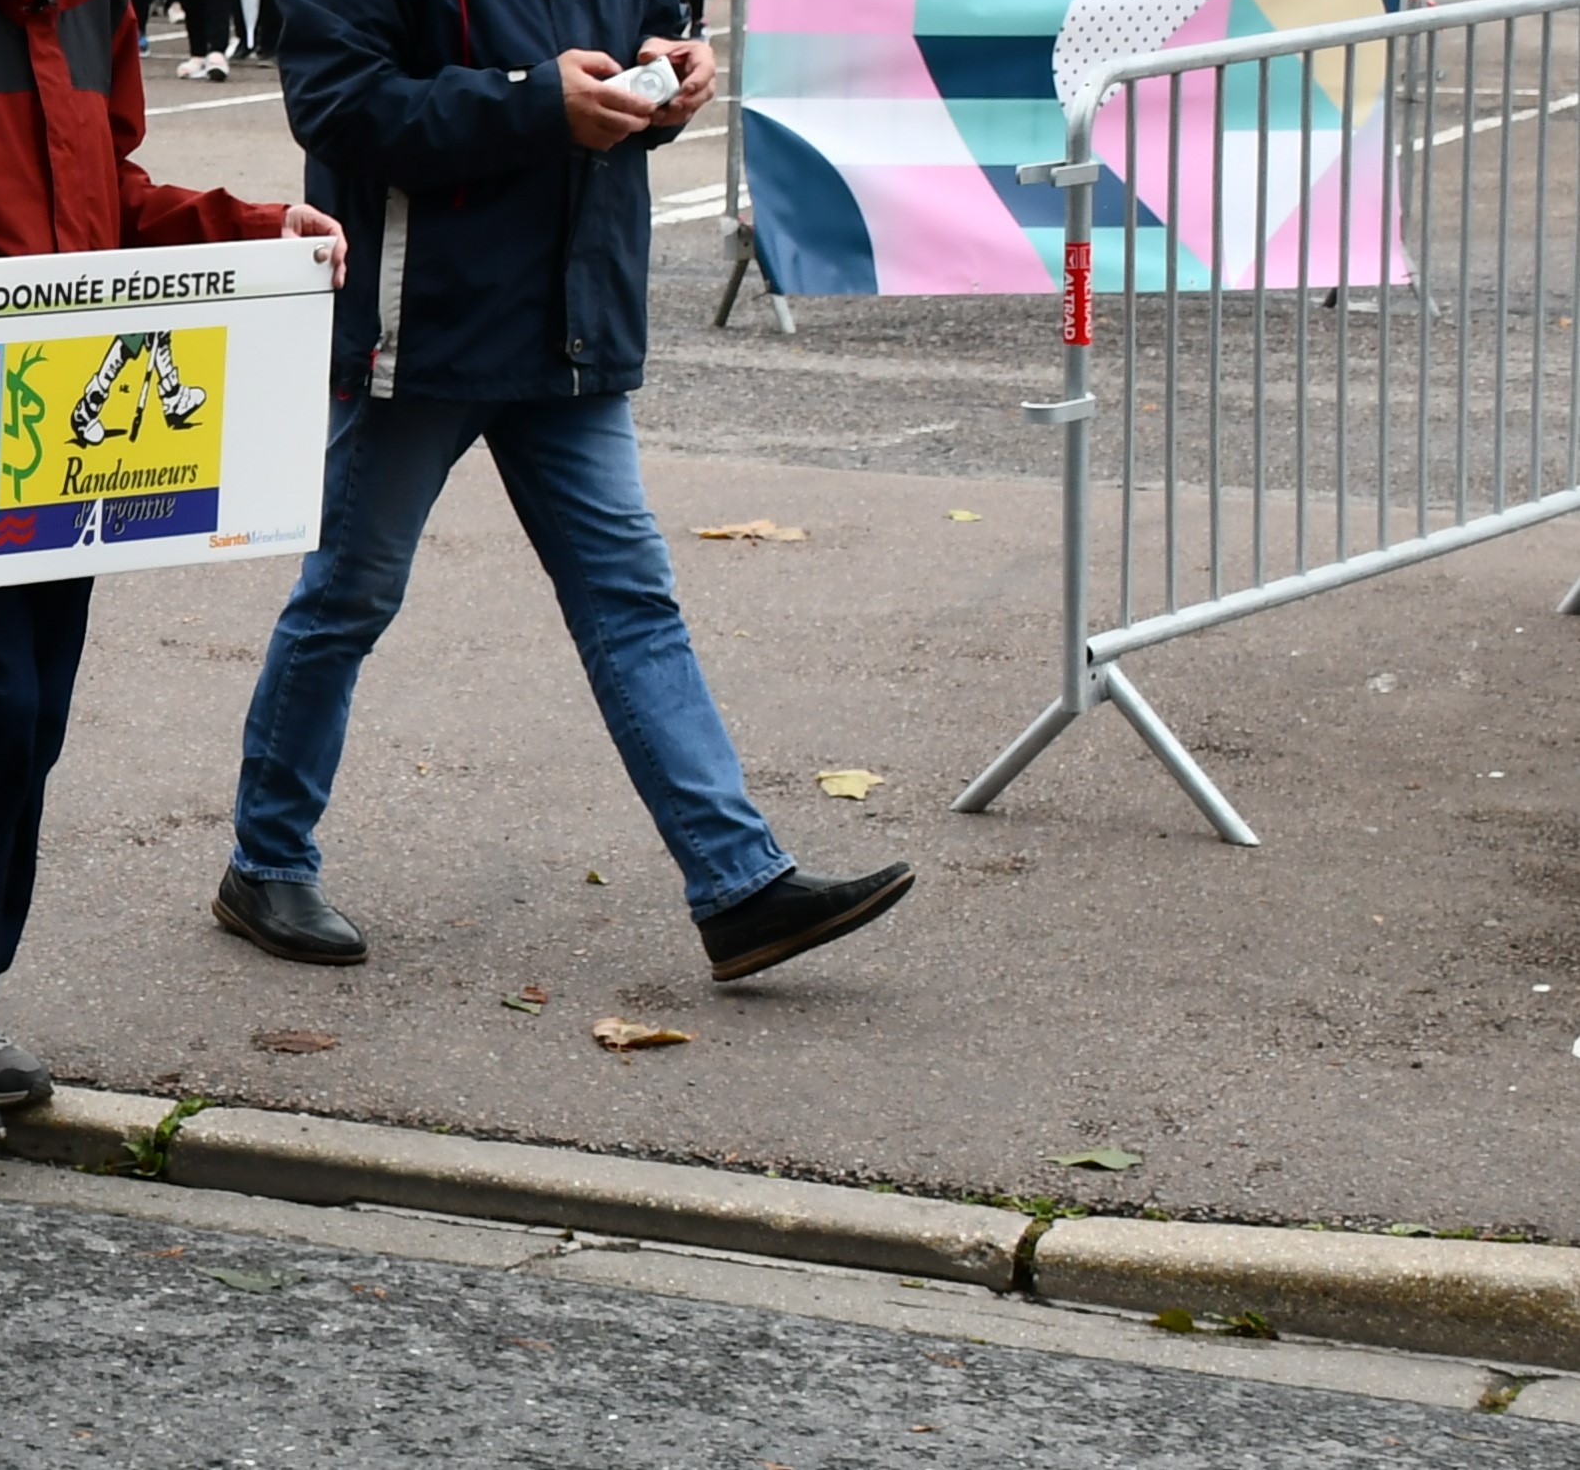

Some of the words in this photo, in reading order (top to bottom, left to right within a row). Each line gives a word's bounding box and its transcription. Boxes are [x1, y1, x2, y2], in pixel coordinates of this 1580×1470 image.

[111, 270, 236, 303] PÉDESTRE
[1064, 272, 1076, 340] ALTRAD
[59, 456, 199, 497] Randonneurs
[73, 496, 177, 547] d'Argonne
